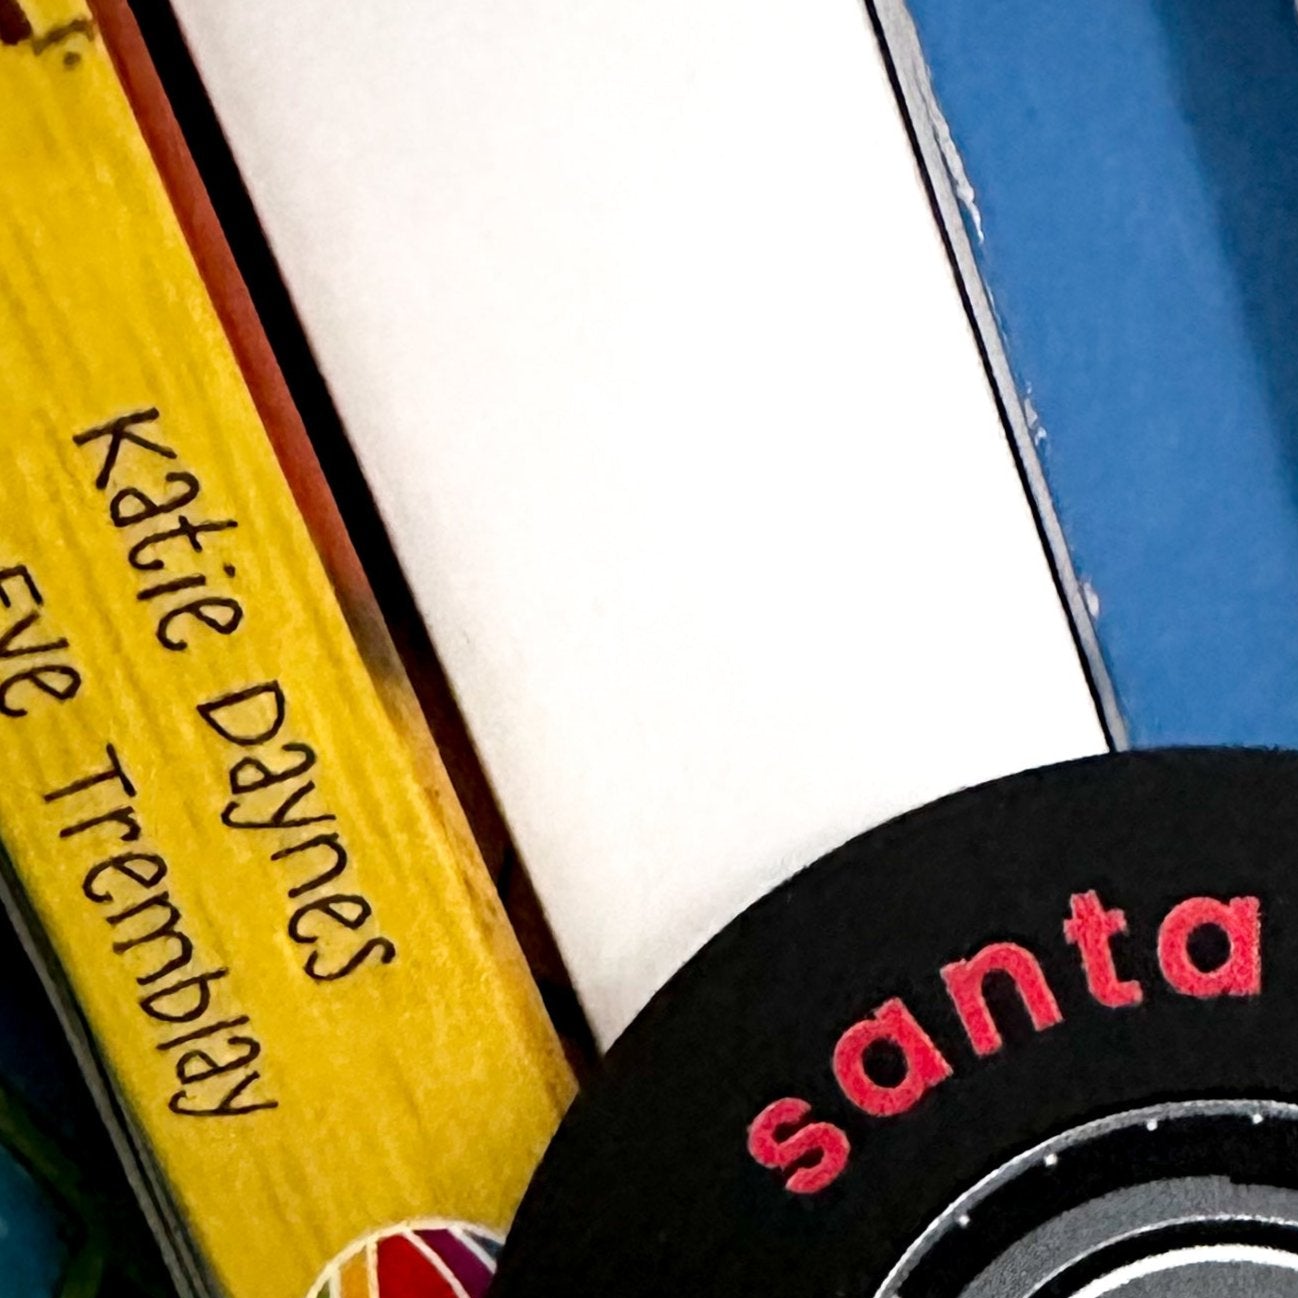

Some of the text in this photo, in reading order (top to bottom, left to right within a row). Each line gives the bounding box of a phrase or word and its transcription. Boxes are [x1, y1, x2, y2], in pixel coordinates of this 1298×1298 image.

[73, 407, 396, 983] Katie Daynes
[44, 743, 278, 1117] Tremblay
[747, 889, 1261, 1194] santa
